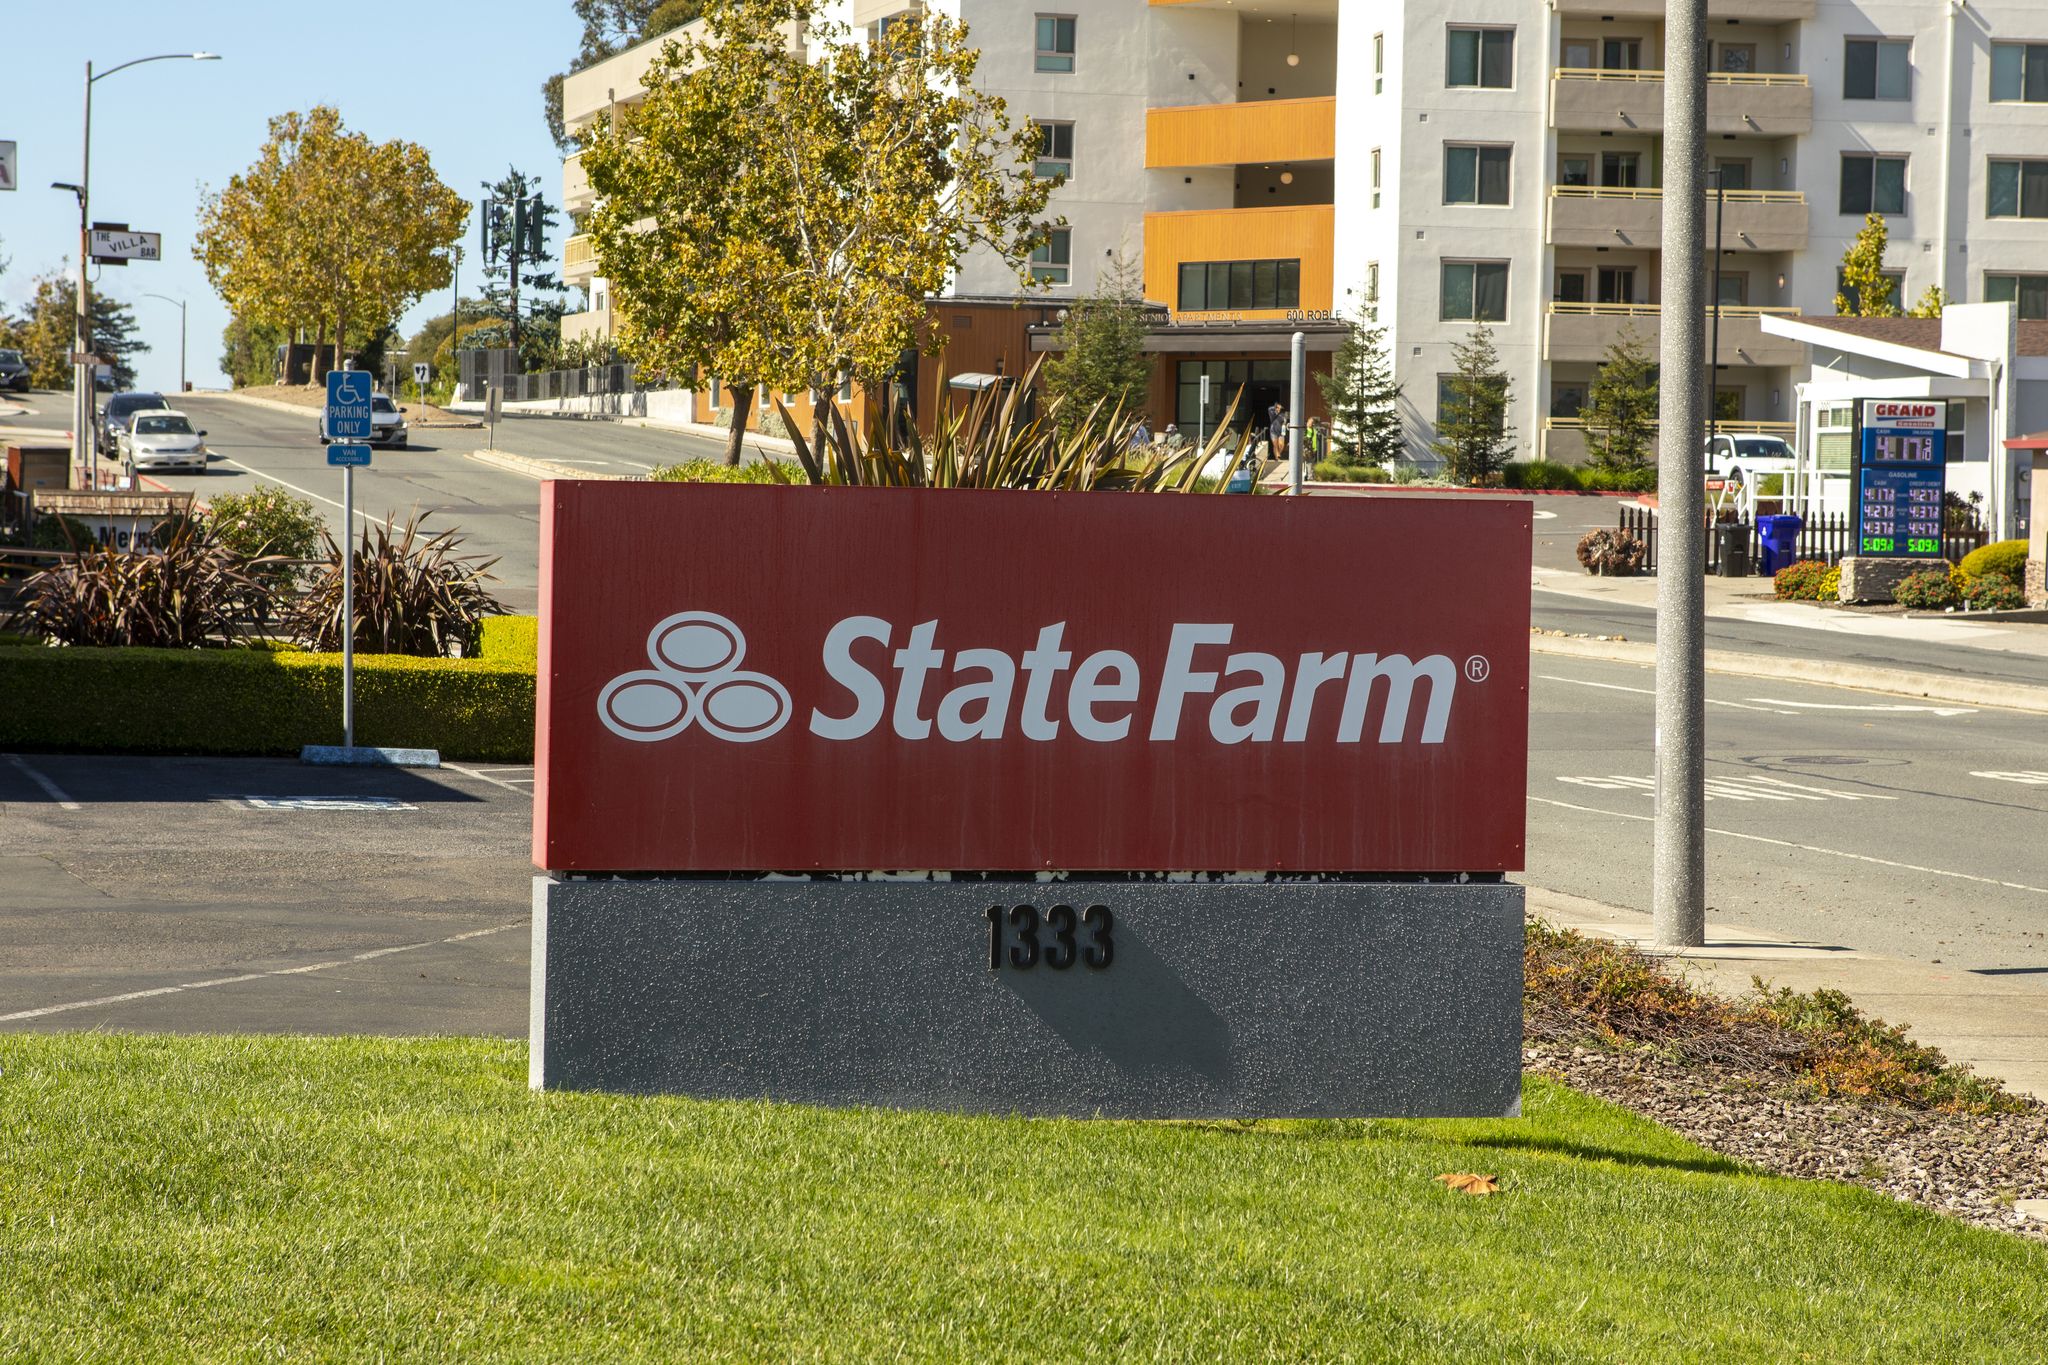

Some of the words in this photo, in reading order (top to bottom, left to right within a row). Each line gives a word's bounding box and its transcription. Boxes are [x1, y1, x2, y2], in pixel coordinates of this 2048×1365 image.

[96, 232, 111, 241] THE
[109, 235, 147, 253] VILLA
[141, 248, 156, 257] BAR
[1139, 313, 1172, 322] SENIOR
[1177, 311, 1242, 321] APARTMENTS
[1286, 310, 1304, 320] 600
[1307, 310, 1342, 320] ROBLE
[329, 406, 369, 418] PARKING
[1876, 404, 1936, 417] GRAND
[337, 421, 360, 433] ONLY
[984, 904, 1114, 970] 1333
